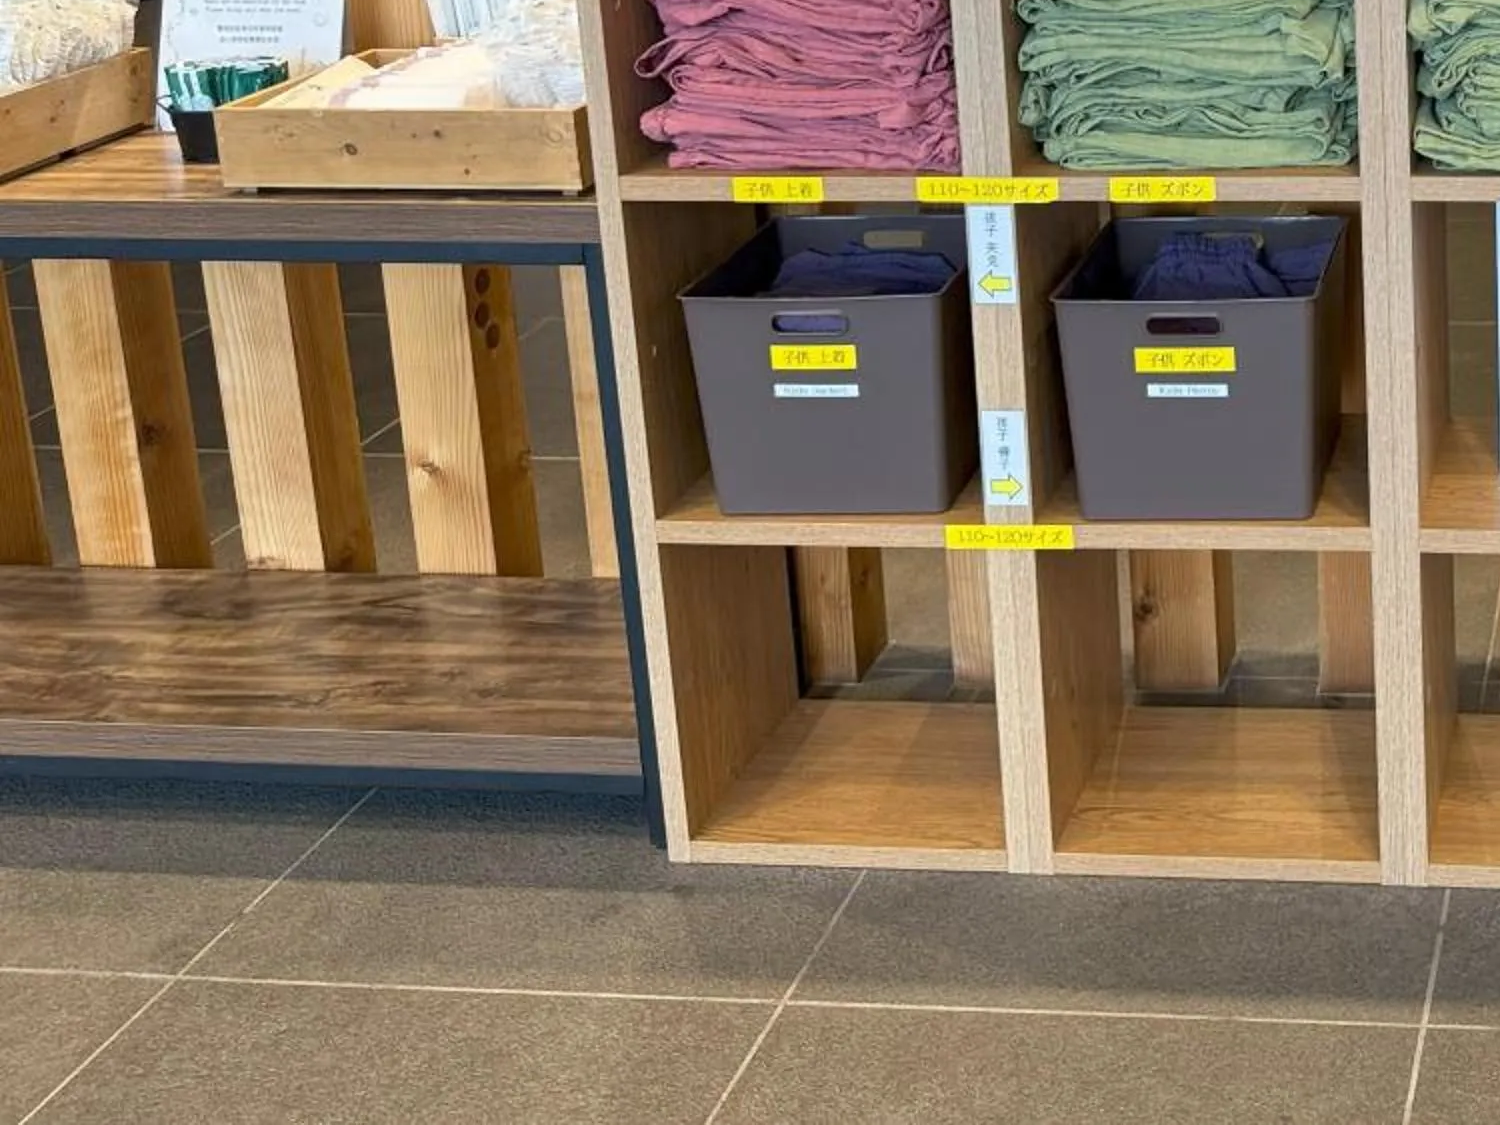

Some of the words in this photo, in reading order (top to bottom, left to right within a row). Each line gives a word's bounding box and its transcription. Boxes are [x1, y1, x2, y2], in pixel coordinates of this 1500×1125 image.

[1160, 181, 1204, 198] ズボン
[1183, 351, 1225, 368] ズボン
